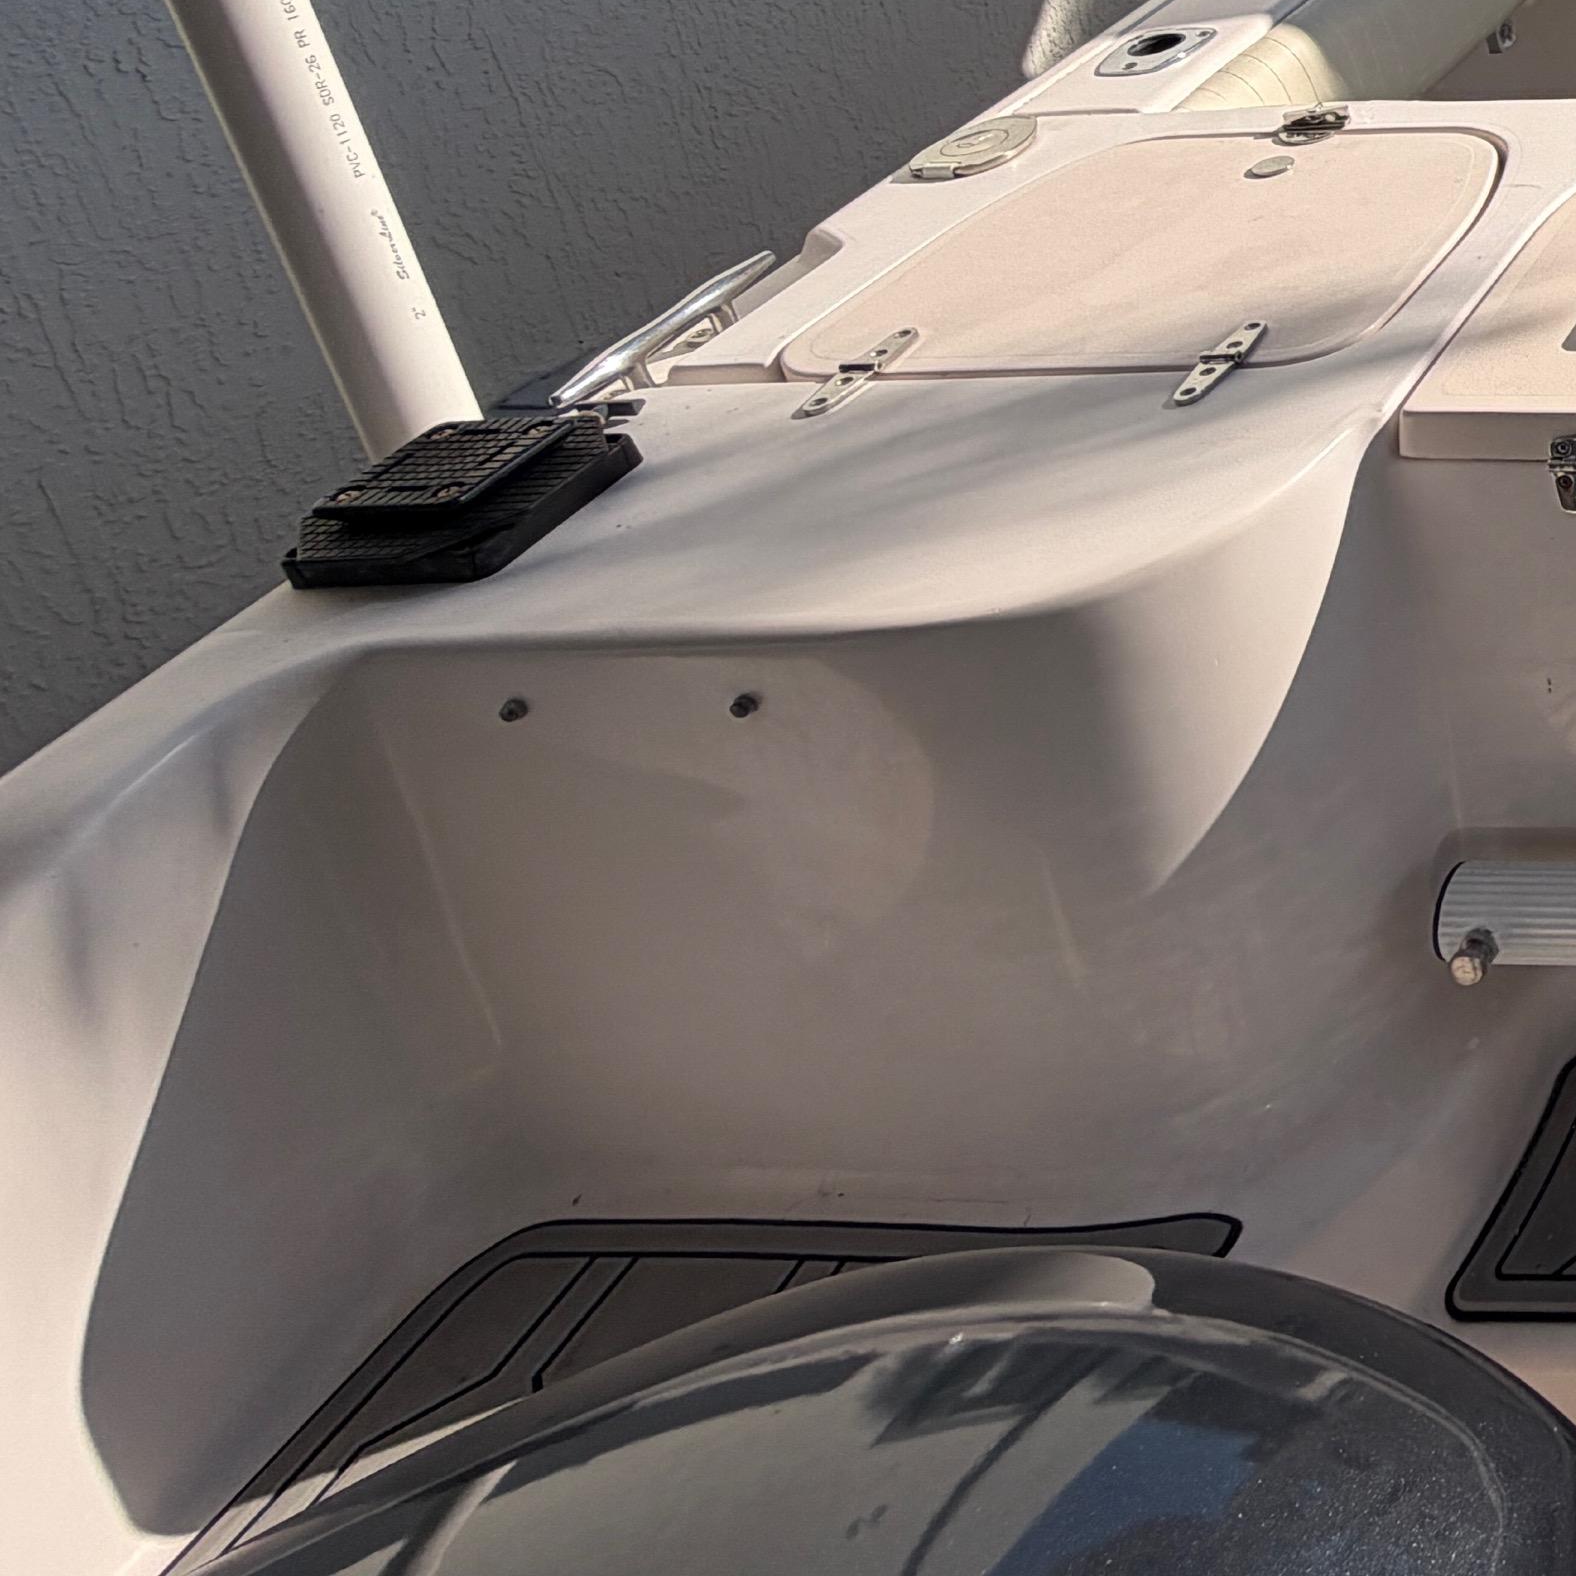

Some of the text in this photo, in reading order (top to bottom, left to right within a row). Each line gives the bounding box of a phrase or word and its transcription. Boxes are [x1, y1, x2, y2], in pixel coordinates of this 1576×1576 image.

[293, 28, 311, 49] PR
[304, 54, 335, 106] SDR-26
[329, 113, 366, 179] PVC-1120
